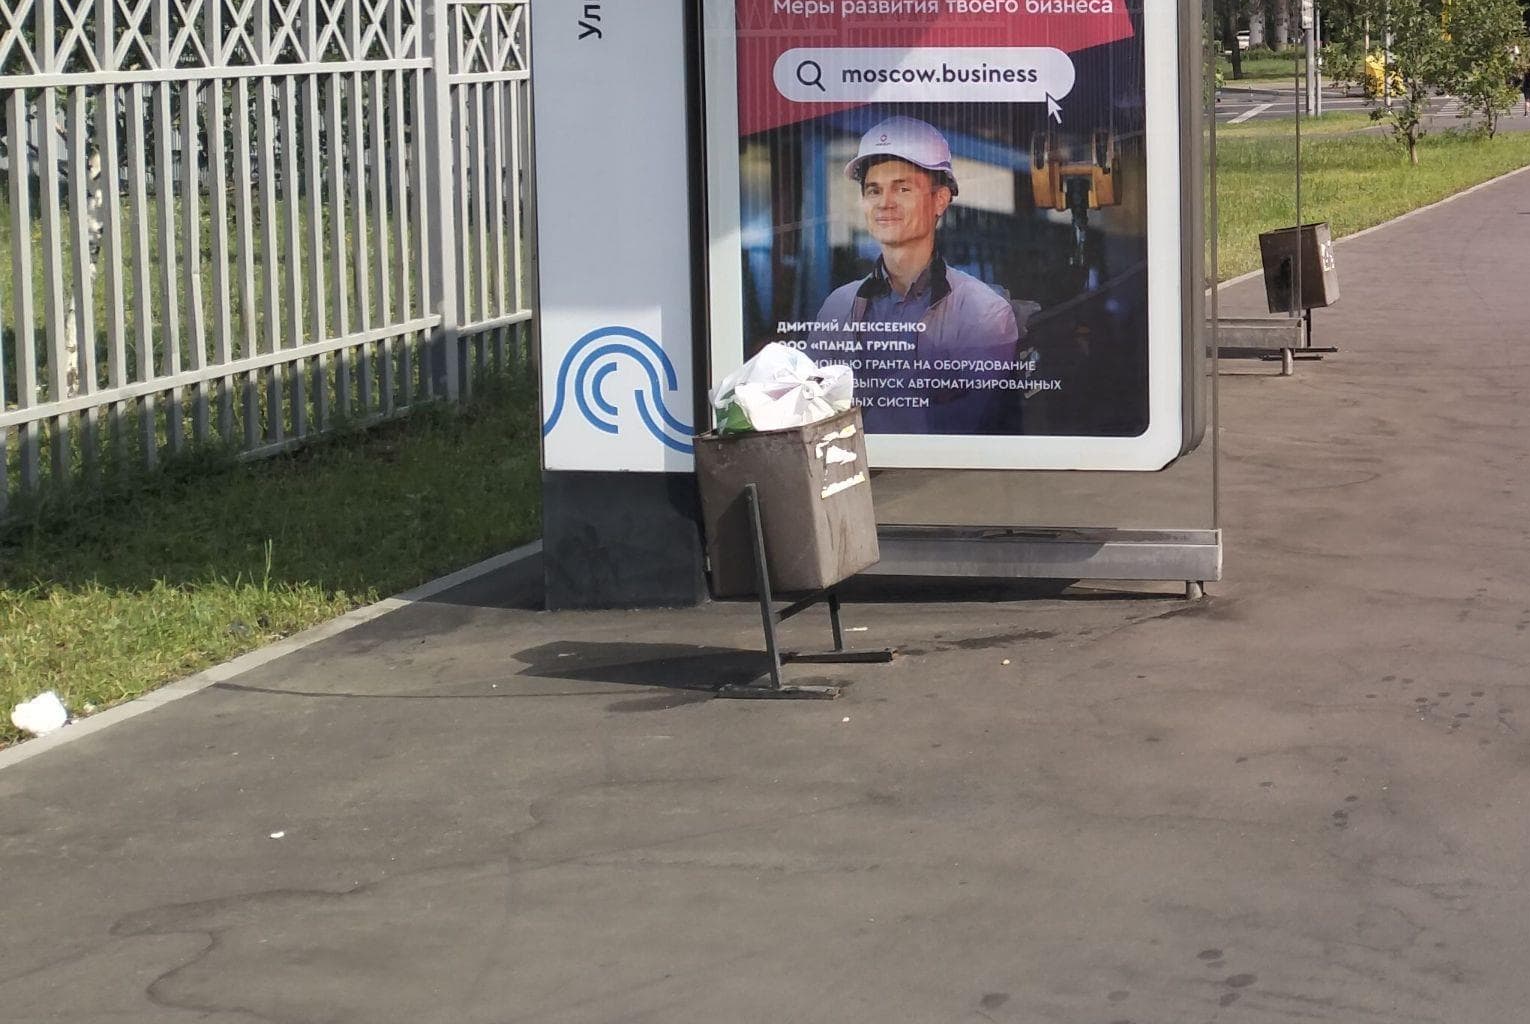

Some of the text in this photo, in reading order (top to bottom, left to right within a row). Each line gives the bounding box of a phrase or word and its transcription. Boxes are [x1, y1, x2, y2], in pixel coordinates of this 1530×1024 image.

[841, 0, 939, 18] развития
[841, 63, 1038, 84] moscow.business
[776, 319, 927, 333] ДМИТРИЙ АЛЕКСЕЕНКО
[810, 341, 863, 353] «ПАНДА
[866, 341, 916, 351] ГРУПП»
[865, 359, 911, 370] ГРАНТА
[913, 359, 931, 370] НА
[933, 359, 1036, 372] ОБОРУДОВАНИЕ
[907, 379, 1062, 390] АВТОМАТИЗИРОВАННЫХ
[877, 397, 930, 408] СИСТЕМ
